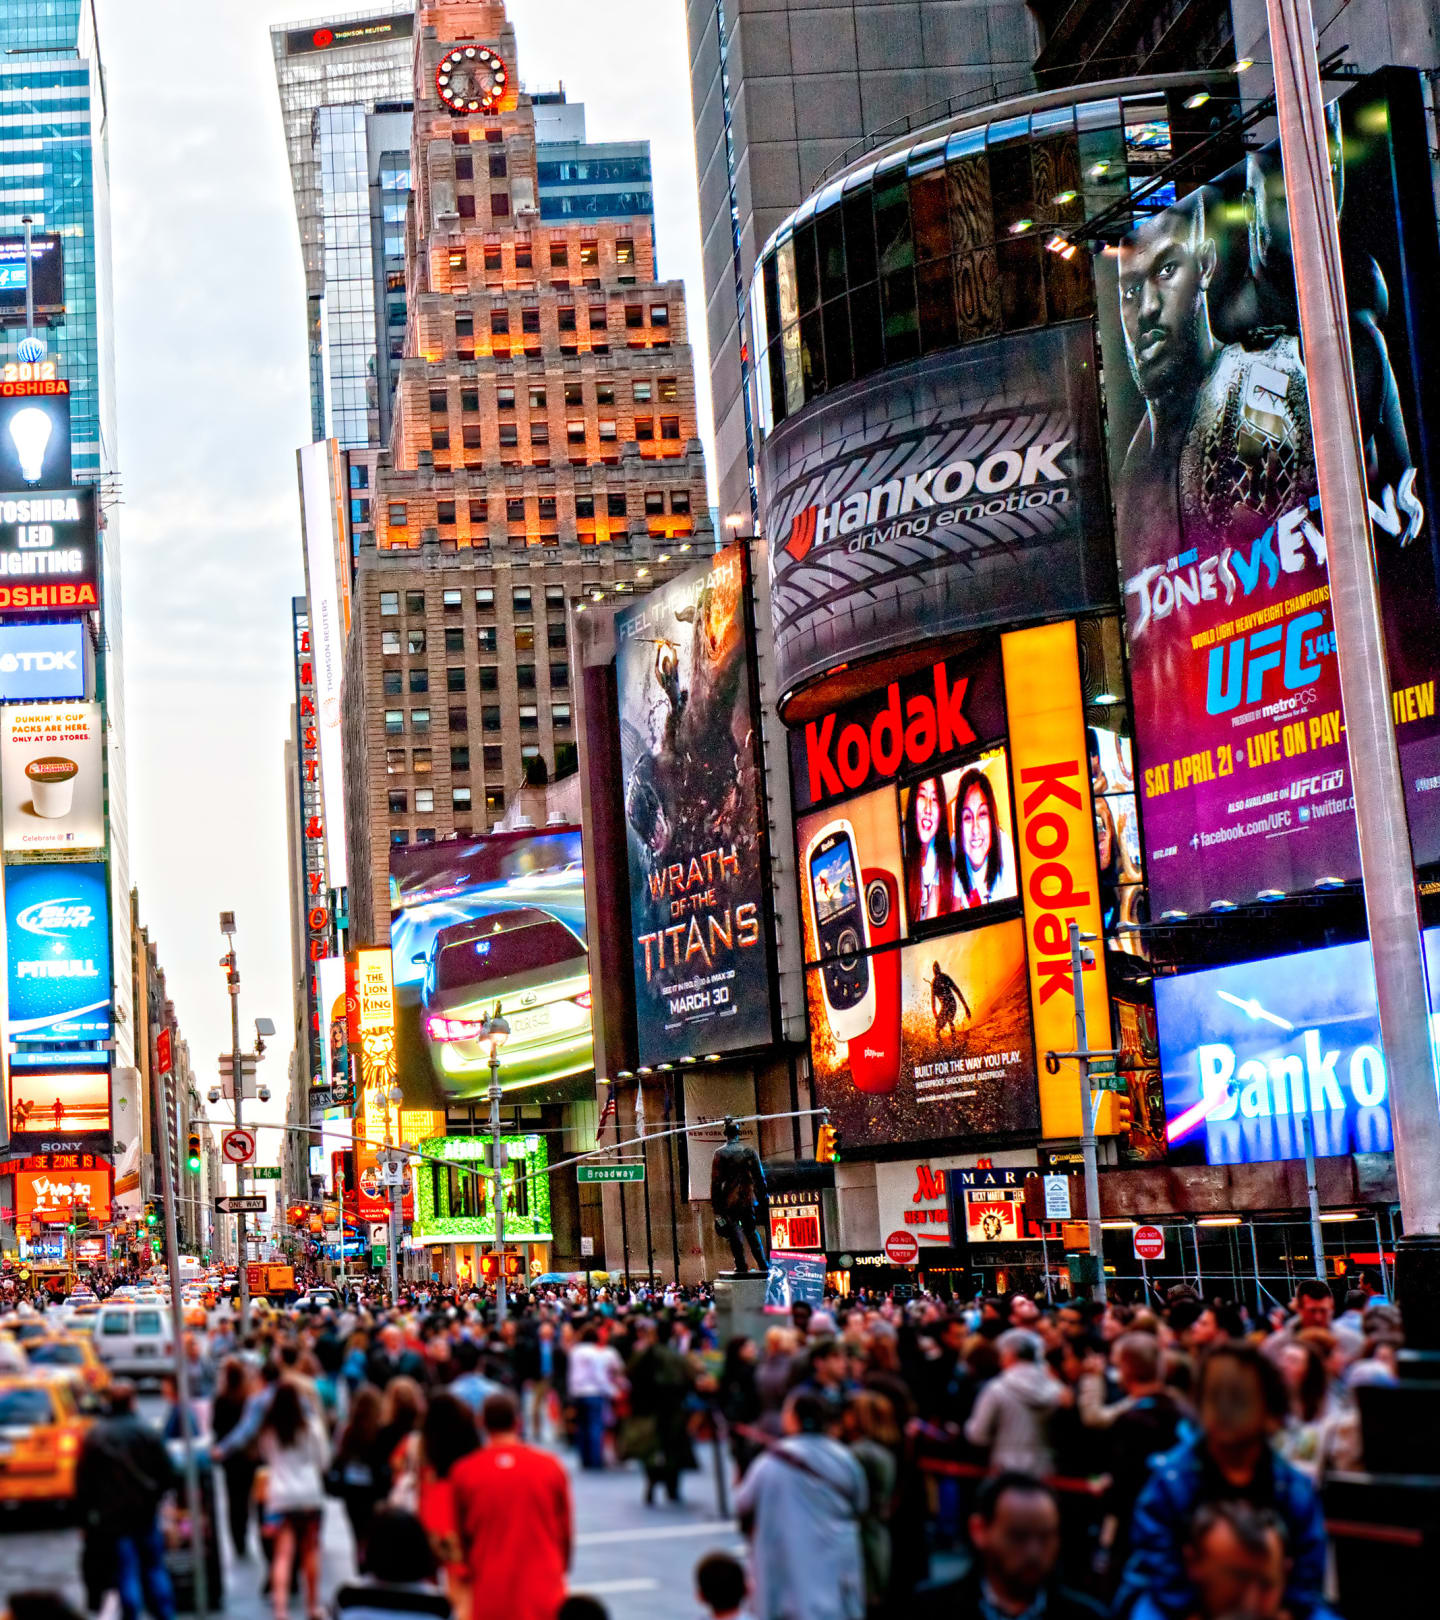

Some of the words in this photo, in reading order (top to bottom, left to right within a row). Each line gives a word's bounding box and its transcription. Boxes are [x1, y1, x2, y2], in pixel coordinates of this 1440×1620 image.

[334, 29, 364, 39] THOMSON
[365, 24, 392, 35] REUTERS
[4, 362, 55, 381] 2012
[848, 515, 930, 553] driving
[936, 487, 1070, 527] emotion
[18, 525, 53, 548] LED
[1191, 631, 1216, 650] WORLD
[1216, 621, 1235, 640] LIGHT
[1235, 602, 1284, 632] HEAVYWEIGHT
[19, 651, 77, 671] TDK
[325, 649, 335, 692] THOMSON
[1207, 611, 1323, 716] UFC
[300, 631, 318, 782] ERNST
[1262, 688, 1317, 718] metroPCS
[12, 725, 41, 733] PACKS
[45, 724, 62, 732] ARE
[65, 723, 90, 731] HERE.
[16, 715, 52, 723] DUNKIN'
[806, 662, 977, 802] Kodak
[1145, 763, 1170, 798] SAT
[1173, 750, 1216, 791] APRIL
[1217, 744, 1233, 777] 21
[1246, 729, 1281, 768] LIVE
[1282, 721, 1307, 758] ON
[1228, 800, 1244, 814] ALSO
[1244, 790, 1279, 810] AVAILABLE
[1279, 788, 1289, 801] ON
[1290, 776, 1320, 800] UFC
[1201, 810, 1292, 848] facebook.com/UFC
[648, 844, 740, 902] WRATH
[1020, 760, 1096, 1005] Kodak
[39, 905, 91, 919] BUD
[671, 897, 688, 918] OF
[690, 888, 718, 911] THE
[30, 916, 95, 929] LIGHT
[637, 902, 759, 983] TITANS
[17, 959, 98, 978] PITBULL
[366, 973, 384, 982] THE
[711, 972, 726, 983] IMAX
[363, 983, 388, 997] LION
[363, 998, 391, 1013] KING
[670, 991, 710, 1015] MARCH
[712, 986, 729, 1004] 30
[914, 1063, 933, 1079] BUILT
[935, 1062, 949, 1075] FOR
[950, 1059, 965, 1072] THE
[965, 1057, 982, 1071] WAY
[983, 1054, 1000, 1068] YOU
[1001, 1050, 1021, 1066] PLAY.
[1199, 1029, 1347, 1122] Bank
[41, 1143, 82, 1152] SONY
[54, 1155, 78, 1168] ZONE
[83, 1155, 93, 1167] IS
[255, 1169, 260, 1177] W
[263, 1169, 272, 1178] 46
[588, 1170, 634, 1178] Broadway
[246, 1200, 261, 1208] WAY
[769, 1192, 820, 1204] MARQUIS
[972, 1191, 985, 1201] RICKY
[904, 1210, 927, 1224] NEW
